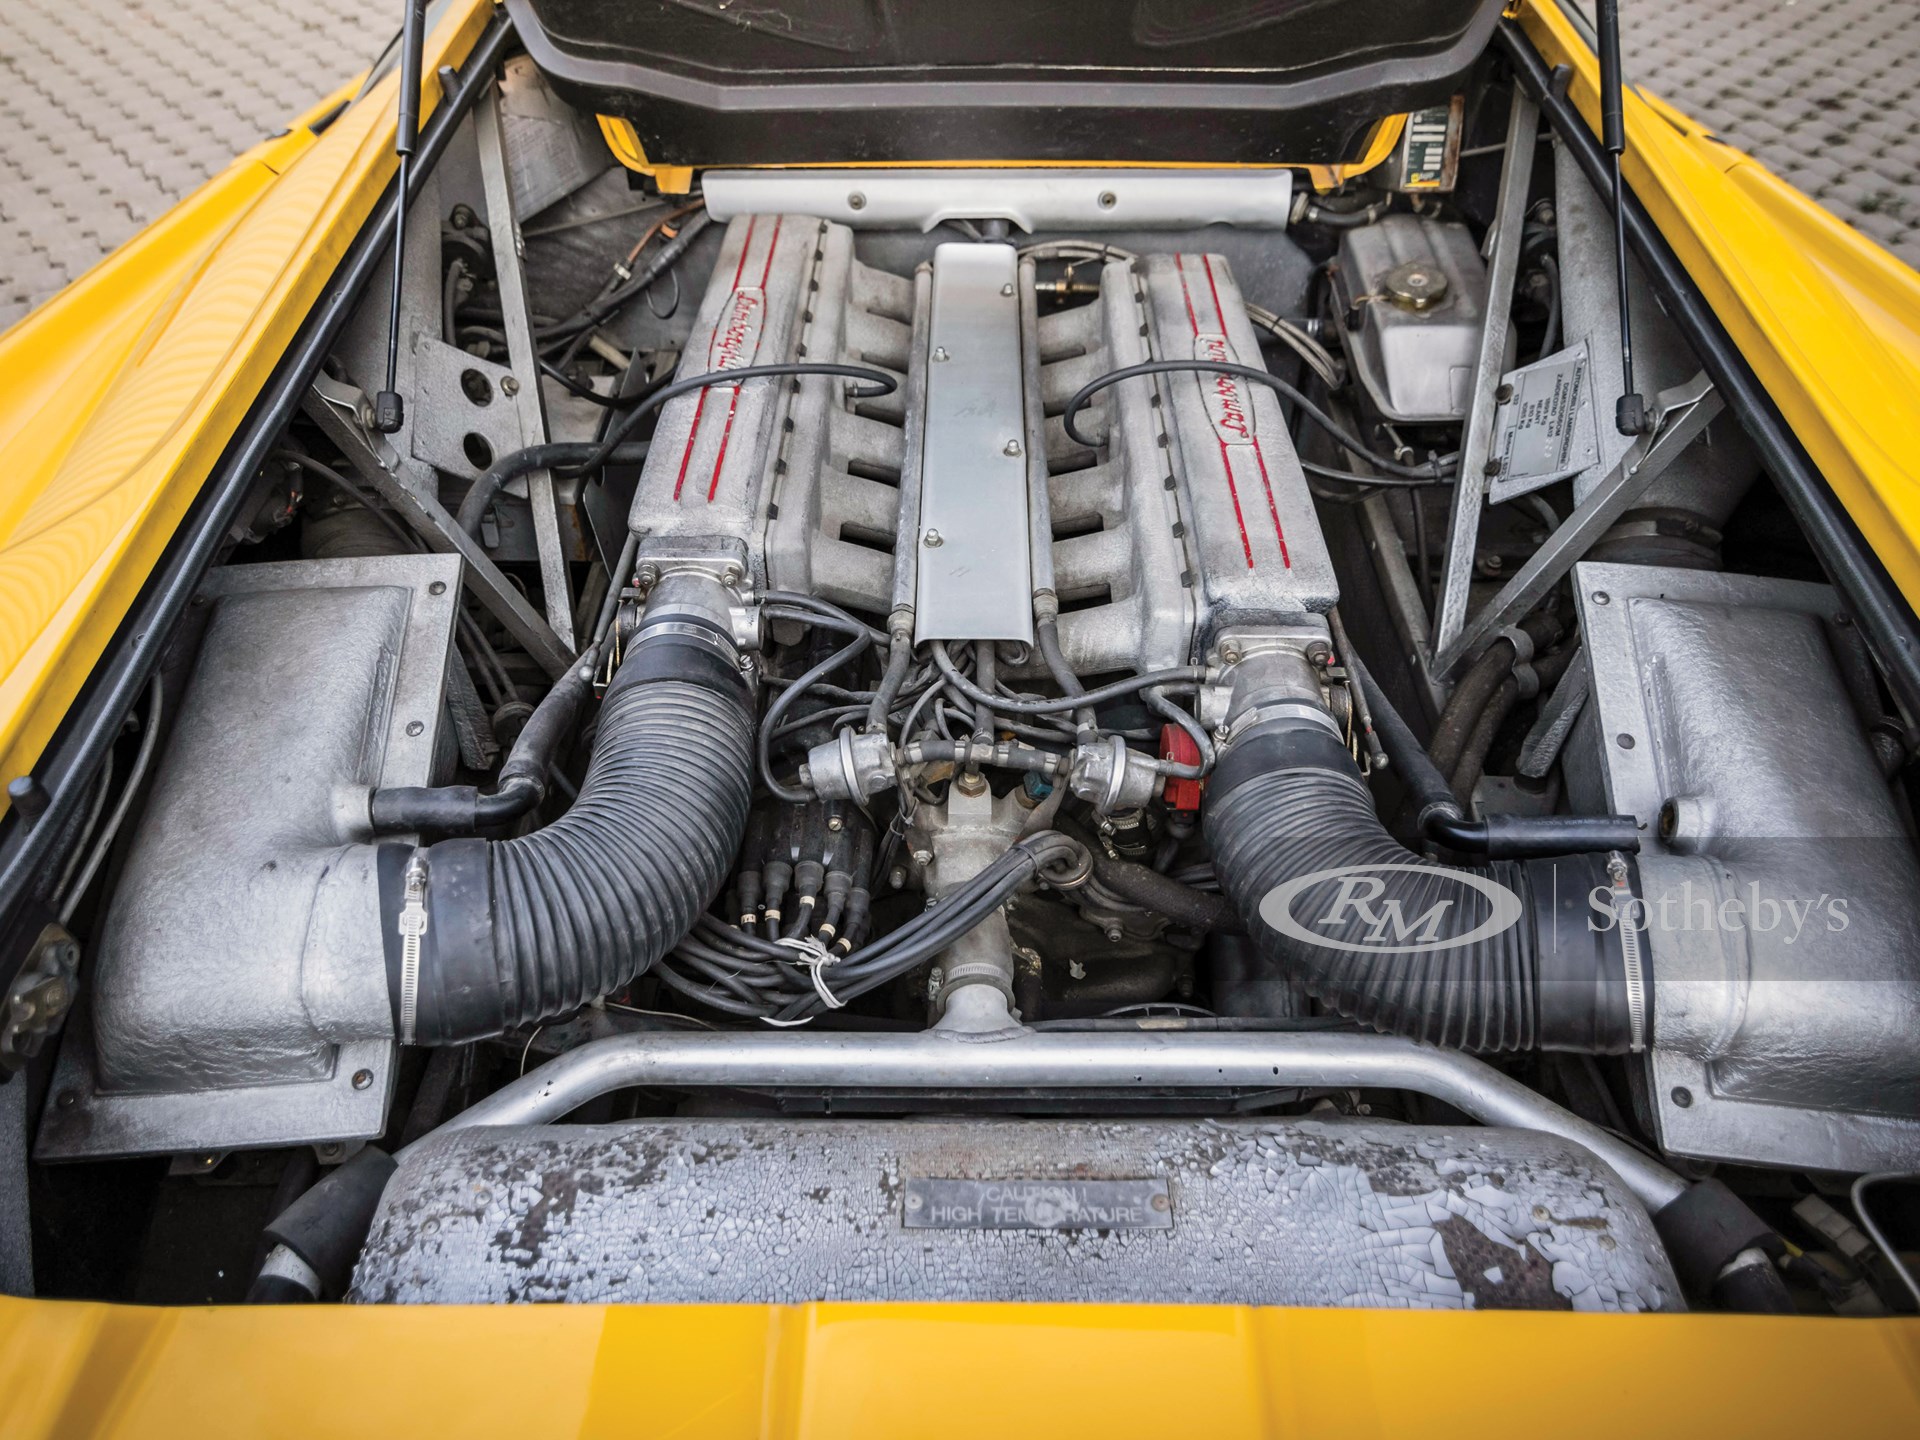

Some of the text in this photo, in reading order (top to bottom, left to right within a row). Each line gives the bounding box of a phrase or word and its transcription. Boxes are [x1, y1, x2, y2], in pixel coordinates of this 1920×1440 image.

[1534, 399, 1543, 424] NEANT
[1561, 367, 1582, 464] AUTOMOBILI LAMBORGHINI
[986, 1186, 1077, 1202] CAUTION
[932, 1206, 1143, 1222] HIGH TEMRATURE
